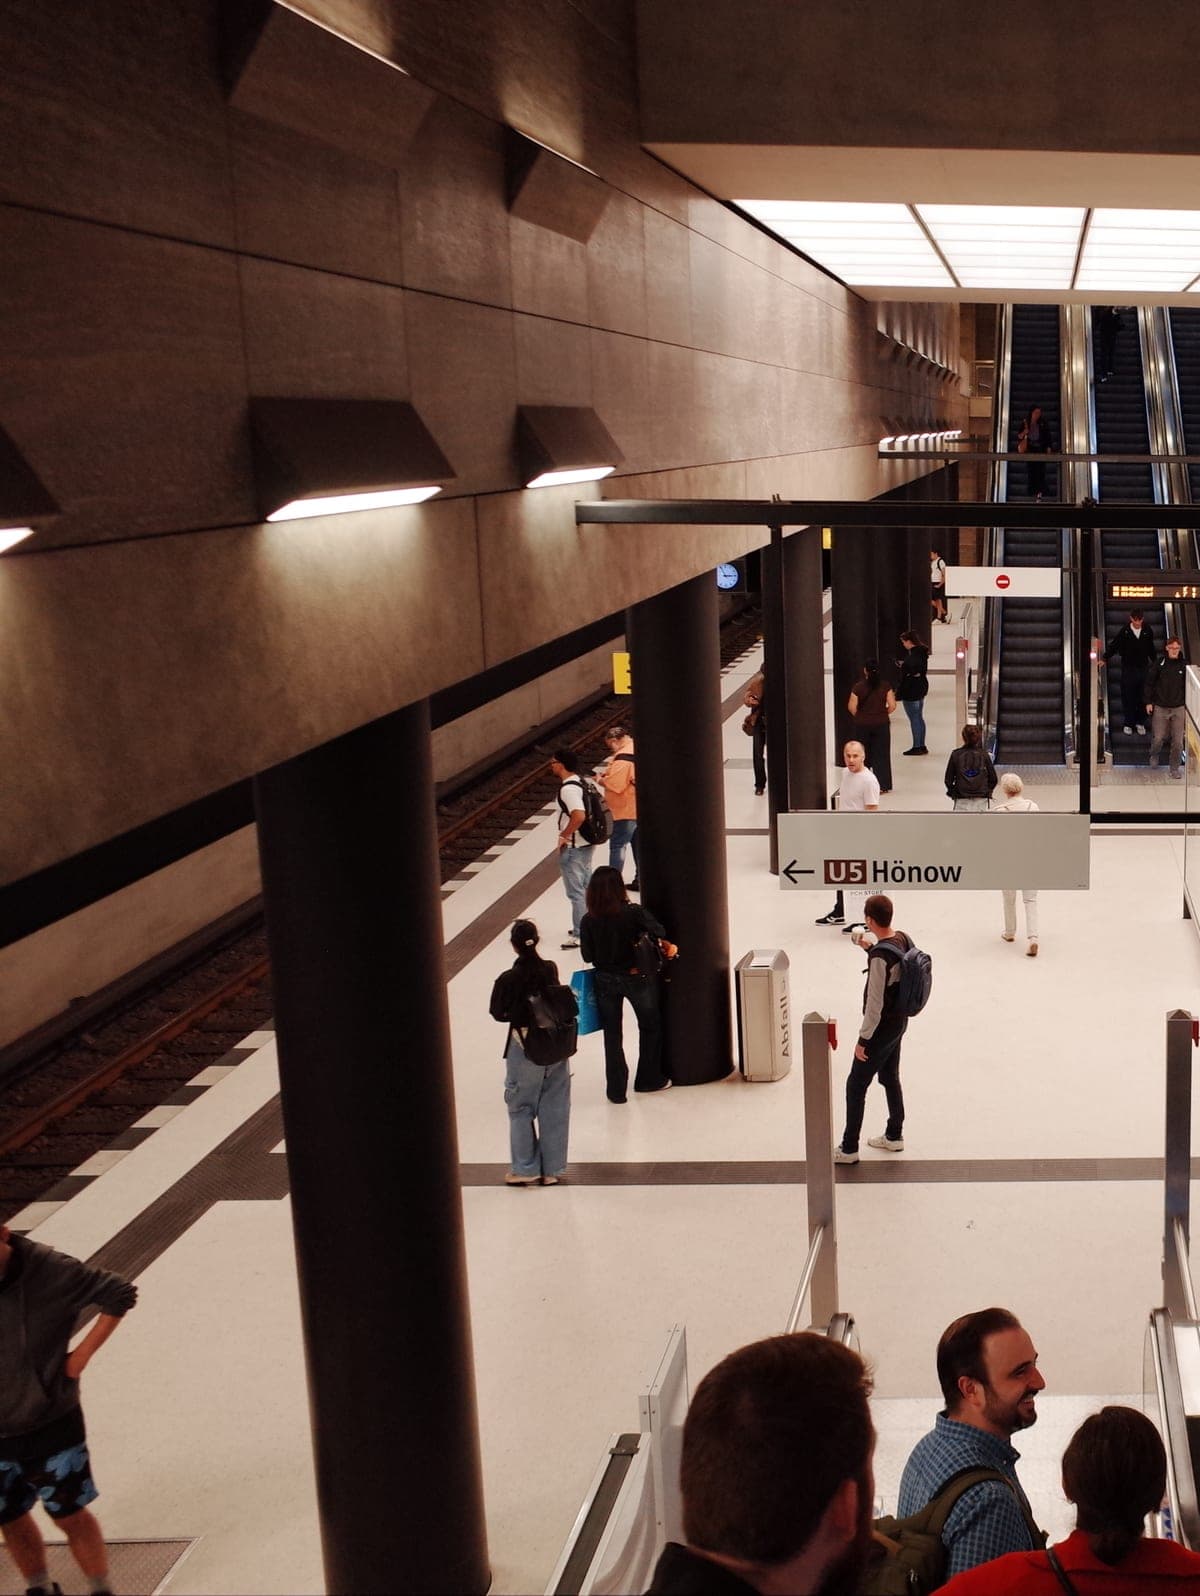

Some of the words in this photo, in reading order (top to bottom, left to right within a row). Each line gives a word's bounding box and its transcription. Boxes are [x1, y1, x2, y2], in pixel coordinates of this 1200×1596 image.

[827, 860, 866, 883] U5
[872, 860, 962, 883] Hönow
[780, 996, 790, 1057] Abfall
